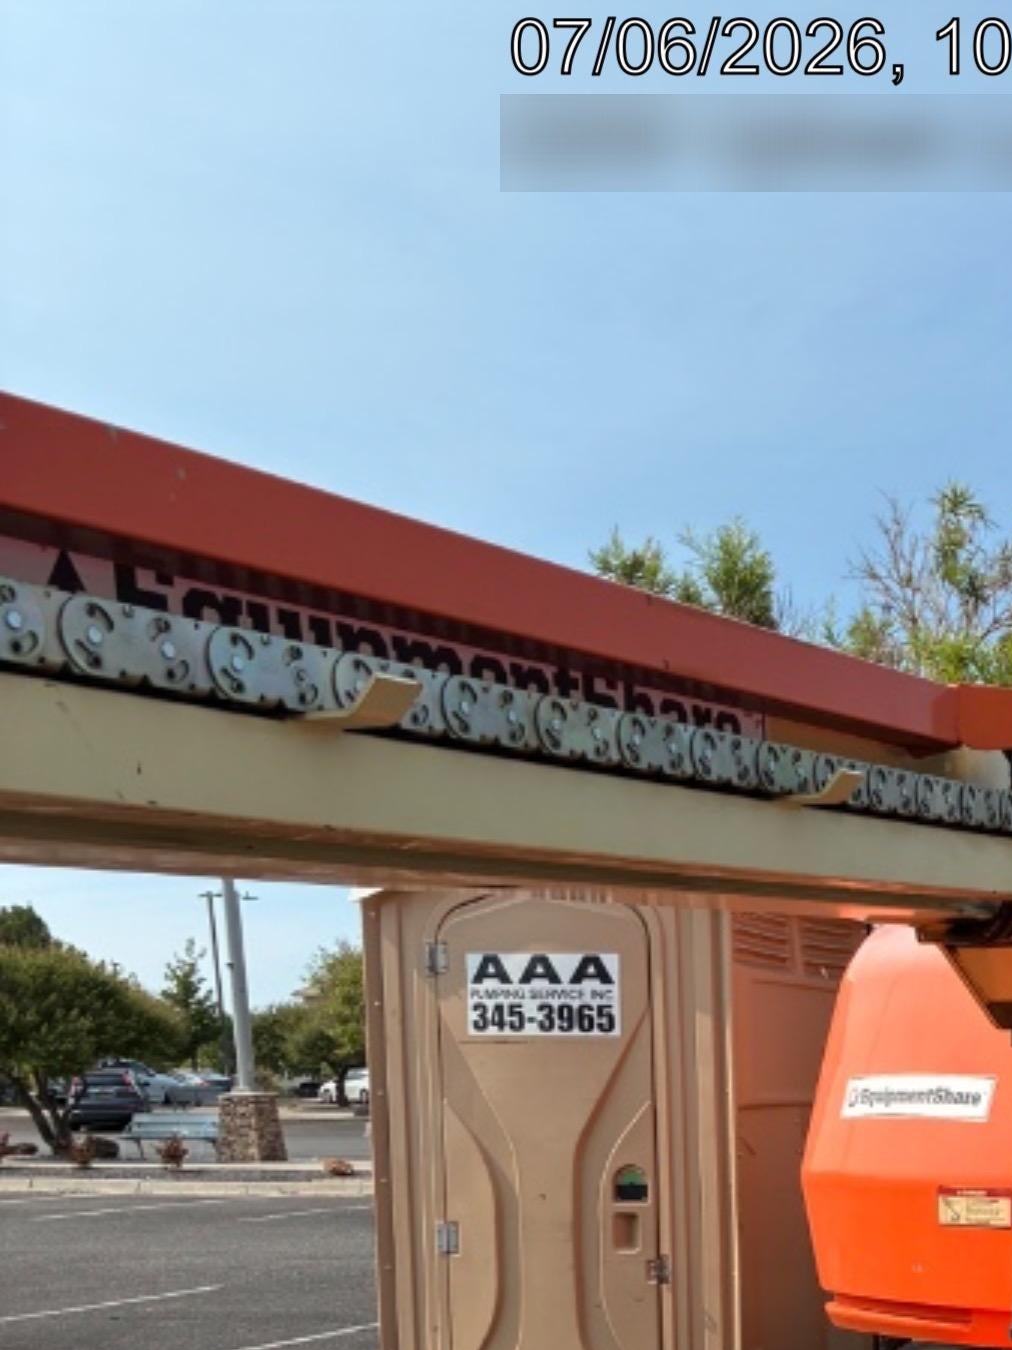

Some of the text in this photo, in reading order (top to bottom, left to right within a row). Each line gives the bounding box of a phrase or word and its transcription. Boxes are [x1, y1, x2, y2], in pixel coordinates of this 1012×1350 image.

[530, 988, 585, 1000] SERVICE
[472, 1003, 616, 1033] 345-3965
[860, 1086, 982, 1107] EquipmentShare
